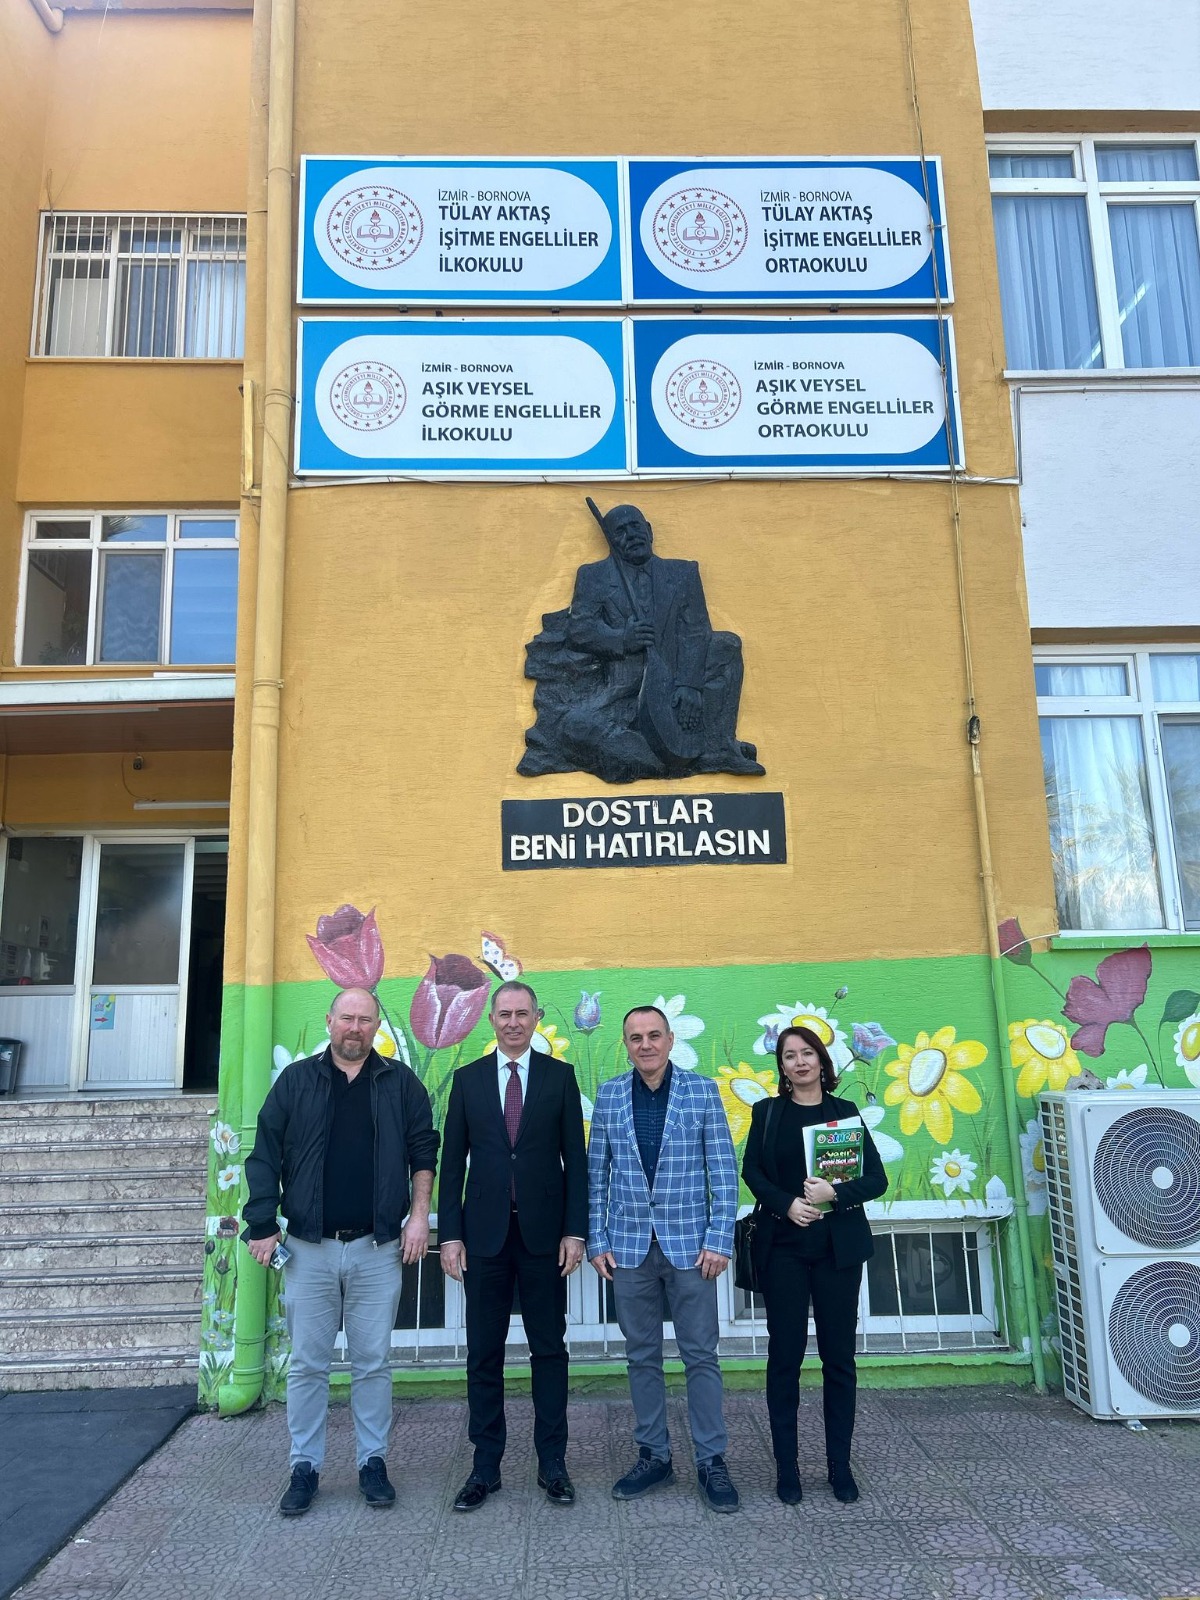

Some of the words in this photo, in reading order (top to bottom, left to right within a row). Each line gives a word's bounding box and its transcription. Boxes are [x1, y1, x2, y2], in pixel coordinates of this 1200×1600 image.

[438, 188, 469, 202] İZMİR
[477, 190, 532, 202] BORNOVA
[760, 189, 791, 202] İZMİR
[799, 191, 853, 202] BORNOVA
[438, 203, 492, 221] TÜLAY
[496, 205, 551, 225] AKTAŞ
[761, 204, 815, 222] TÜLAY
[819, 205, 873, 225] AKTAŞ
[439, 229, 496, 251] İŞİTME
[499, 228, 599, 247] ENGELLİLER
[763, 229, 820, 252] İŞİTME
[823, 227, 922, 247] ENGELLİLER
[439, 254, 523, 273] İLKOKULU
[765, 257, 868, 273] ORTAOKULU
[421, 362, 452, 373] İZMİR
[460, 363, 514, 373] BORNOVA
[754, 359, 784, 371] İZMİR
[792, 361, 845, 371] BORNOVA
[421, 382, 463, 399] AŞIK
[467, 382, 534, 396] VEYSEL
[755, 378, 797, 395] AŞIK
[800, 378, 867, 393] VEYSEL
[421, 401, 490, 419] GÖRME
[494, 401, 602, 419] ENGELLİLER
[756, 398, 824, 416] GÖRME
[828, 397, 934, 415] ENGELLİLER
[421, 424, 513, 442] İLKOKULU
[757, 423, 869, 438] ORTAOKULU
[562, 799, 714, 828] DOSTLAR
[585, 829, 771, 859] HATIRLASIN
